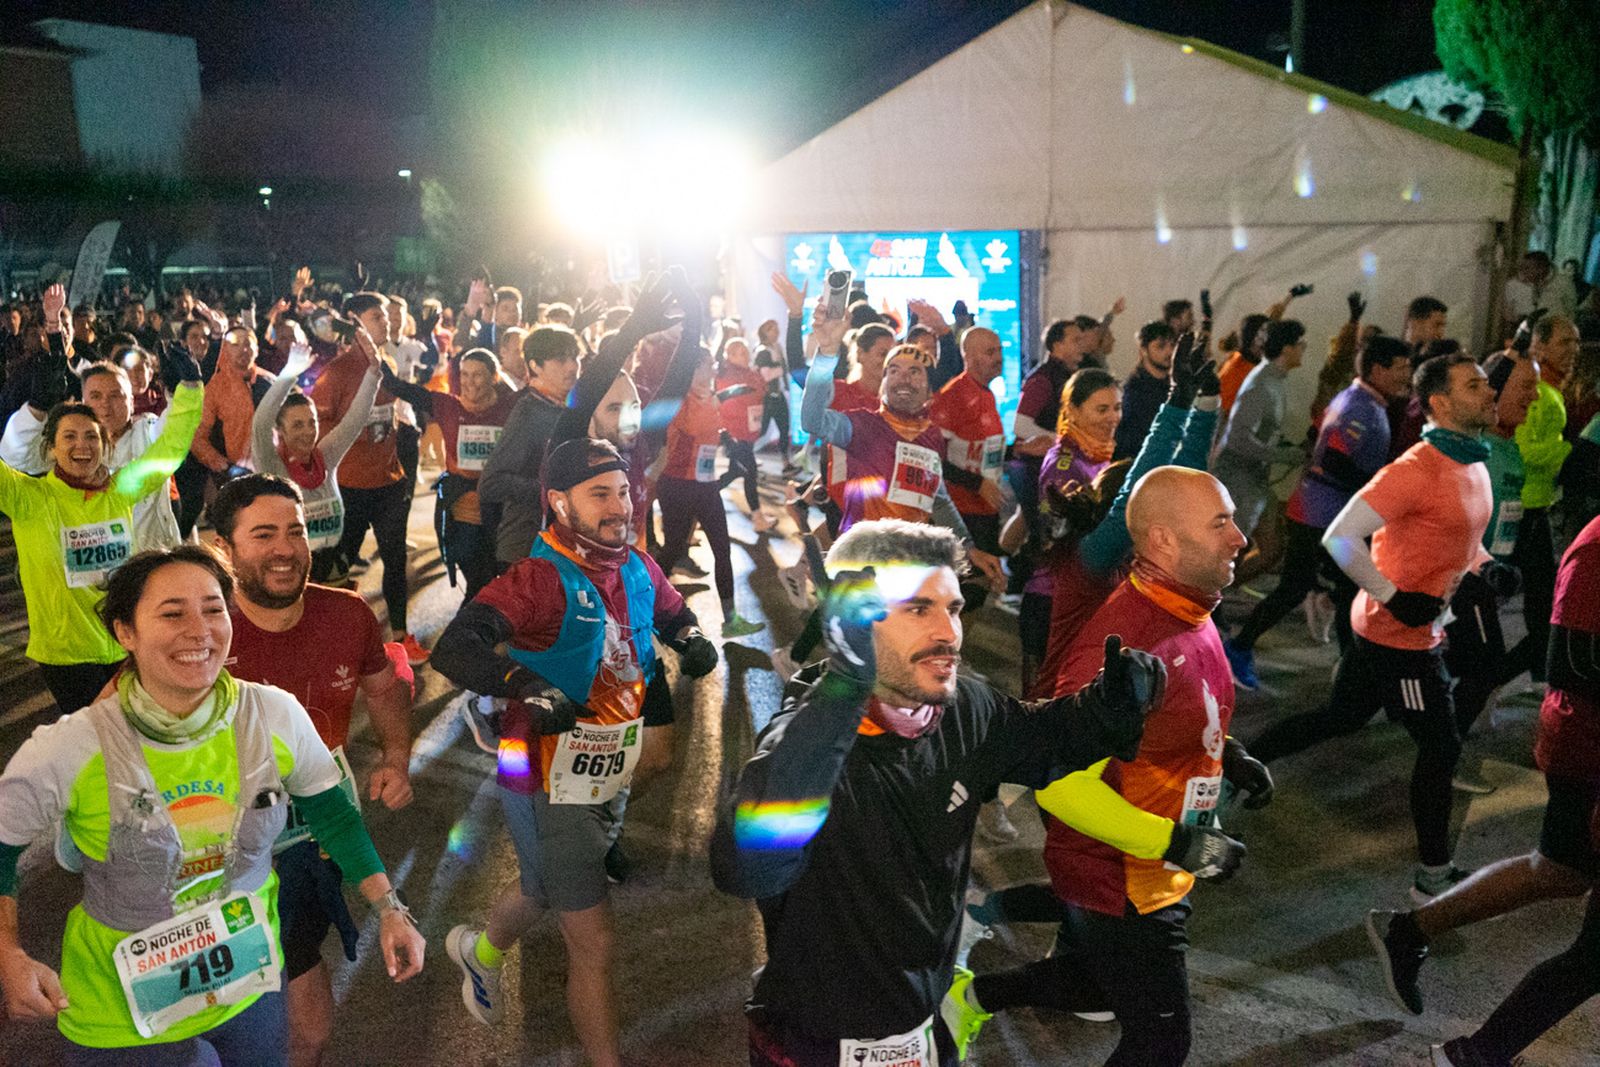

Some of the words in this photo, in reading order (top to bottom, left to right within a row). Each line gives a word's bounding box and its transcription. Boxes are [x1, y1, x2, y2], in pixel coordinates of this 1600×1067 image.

[891, 238, 927, 257] SAN
[72, 541, 126, 566] 12865
[568, 741, 589, 752] SAN
[583, 733, 611, 742] NOCHE
[571, 750, 625, 777] 6679
[150, 926, 195, 952] NOCHE
[195, 917, 213, 934] DE
[137, 950, 167, 974] SAN
[170, 931, 217, 961] ANTÓN
[171, 944, 234, 991] 719
[870, 1046, 909, 1062] NOCHE
